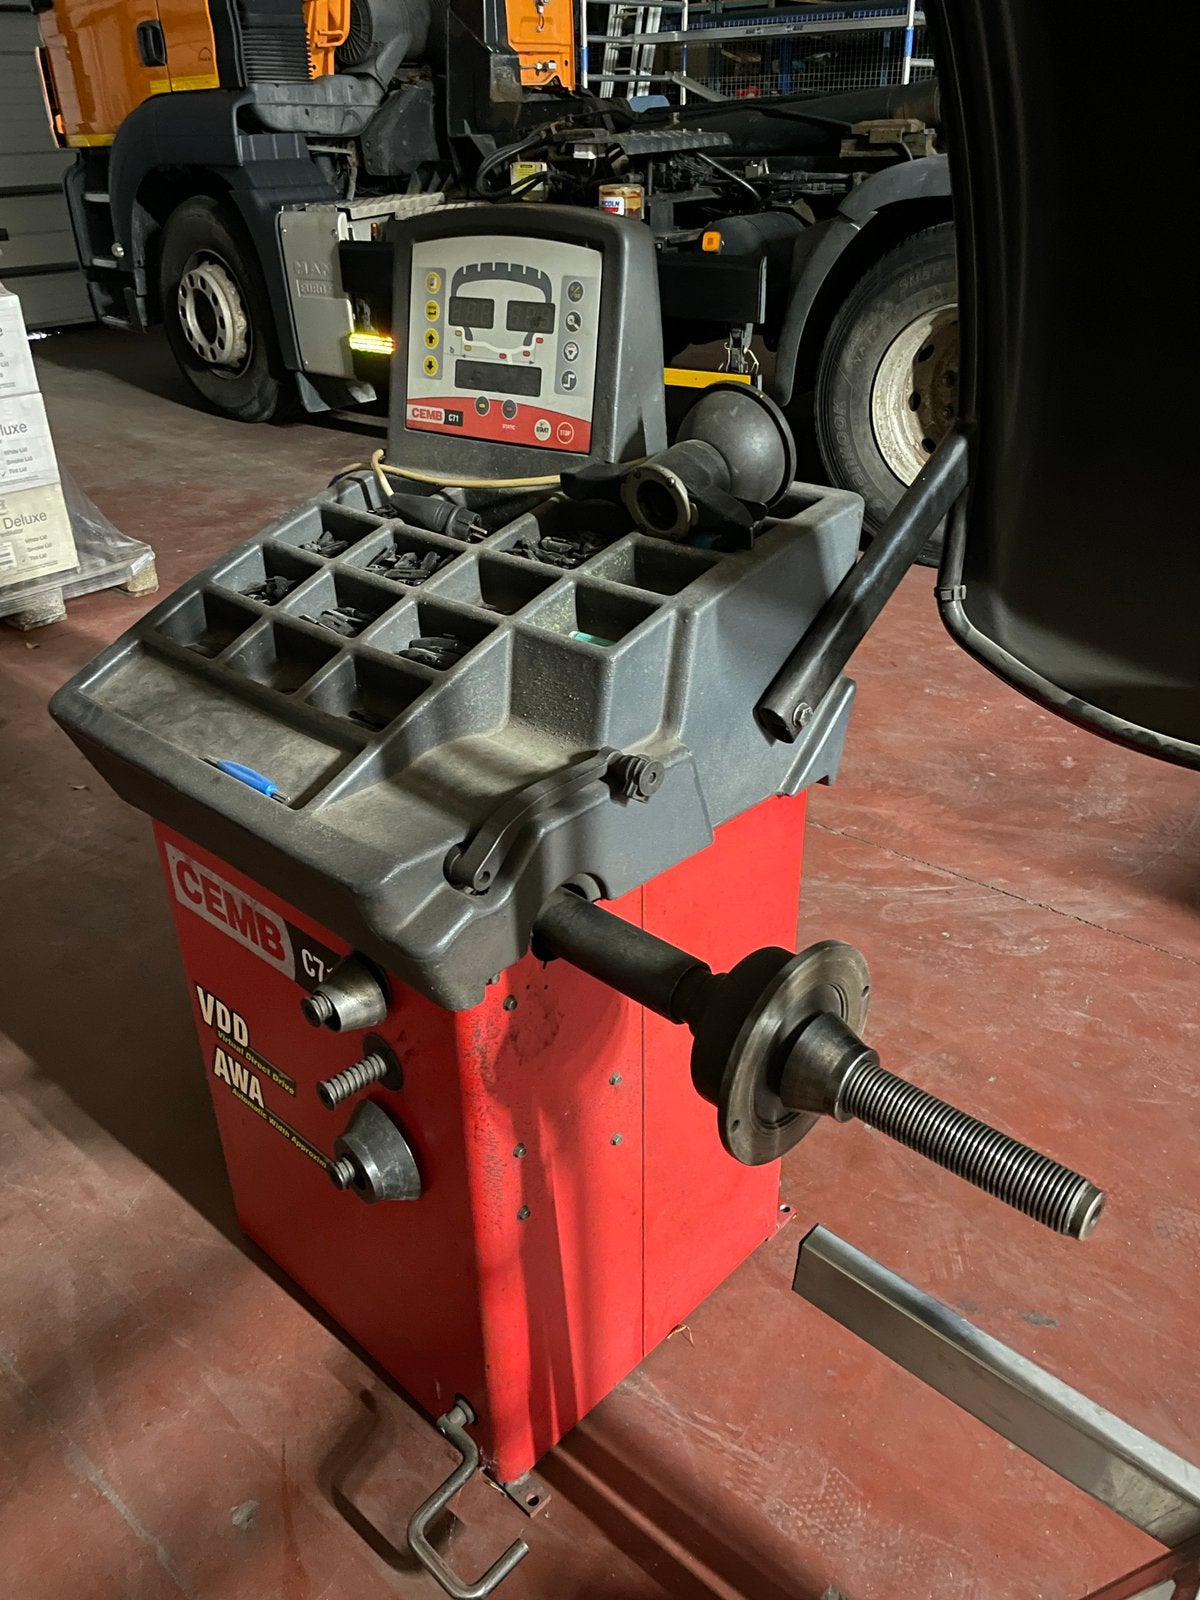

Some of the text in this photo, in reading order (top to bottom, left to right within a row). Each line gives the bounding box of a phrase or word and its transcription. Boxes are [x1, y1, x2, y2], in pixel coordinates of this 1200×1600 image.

[0, 423, 28, 436] luxe
[412, 408, 459, 422] CEMB C71
[3, 512, 48, 530] Deluxe
[175, 859, 333, 983] CEMB C7
[196, 985, 249, 1048] VDD
[213, 1047, 265, 1108] AWA
[217, 1030, 295, 1095] Virtual Direct Drive
[232, 1087, 328, 1169] Automatic Width Approxim
